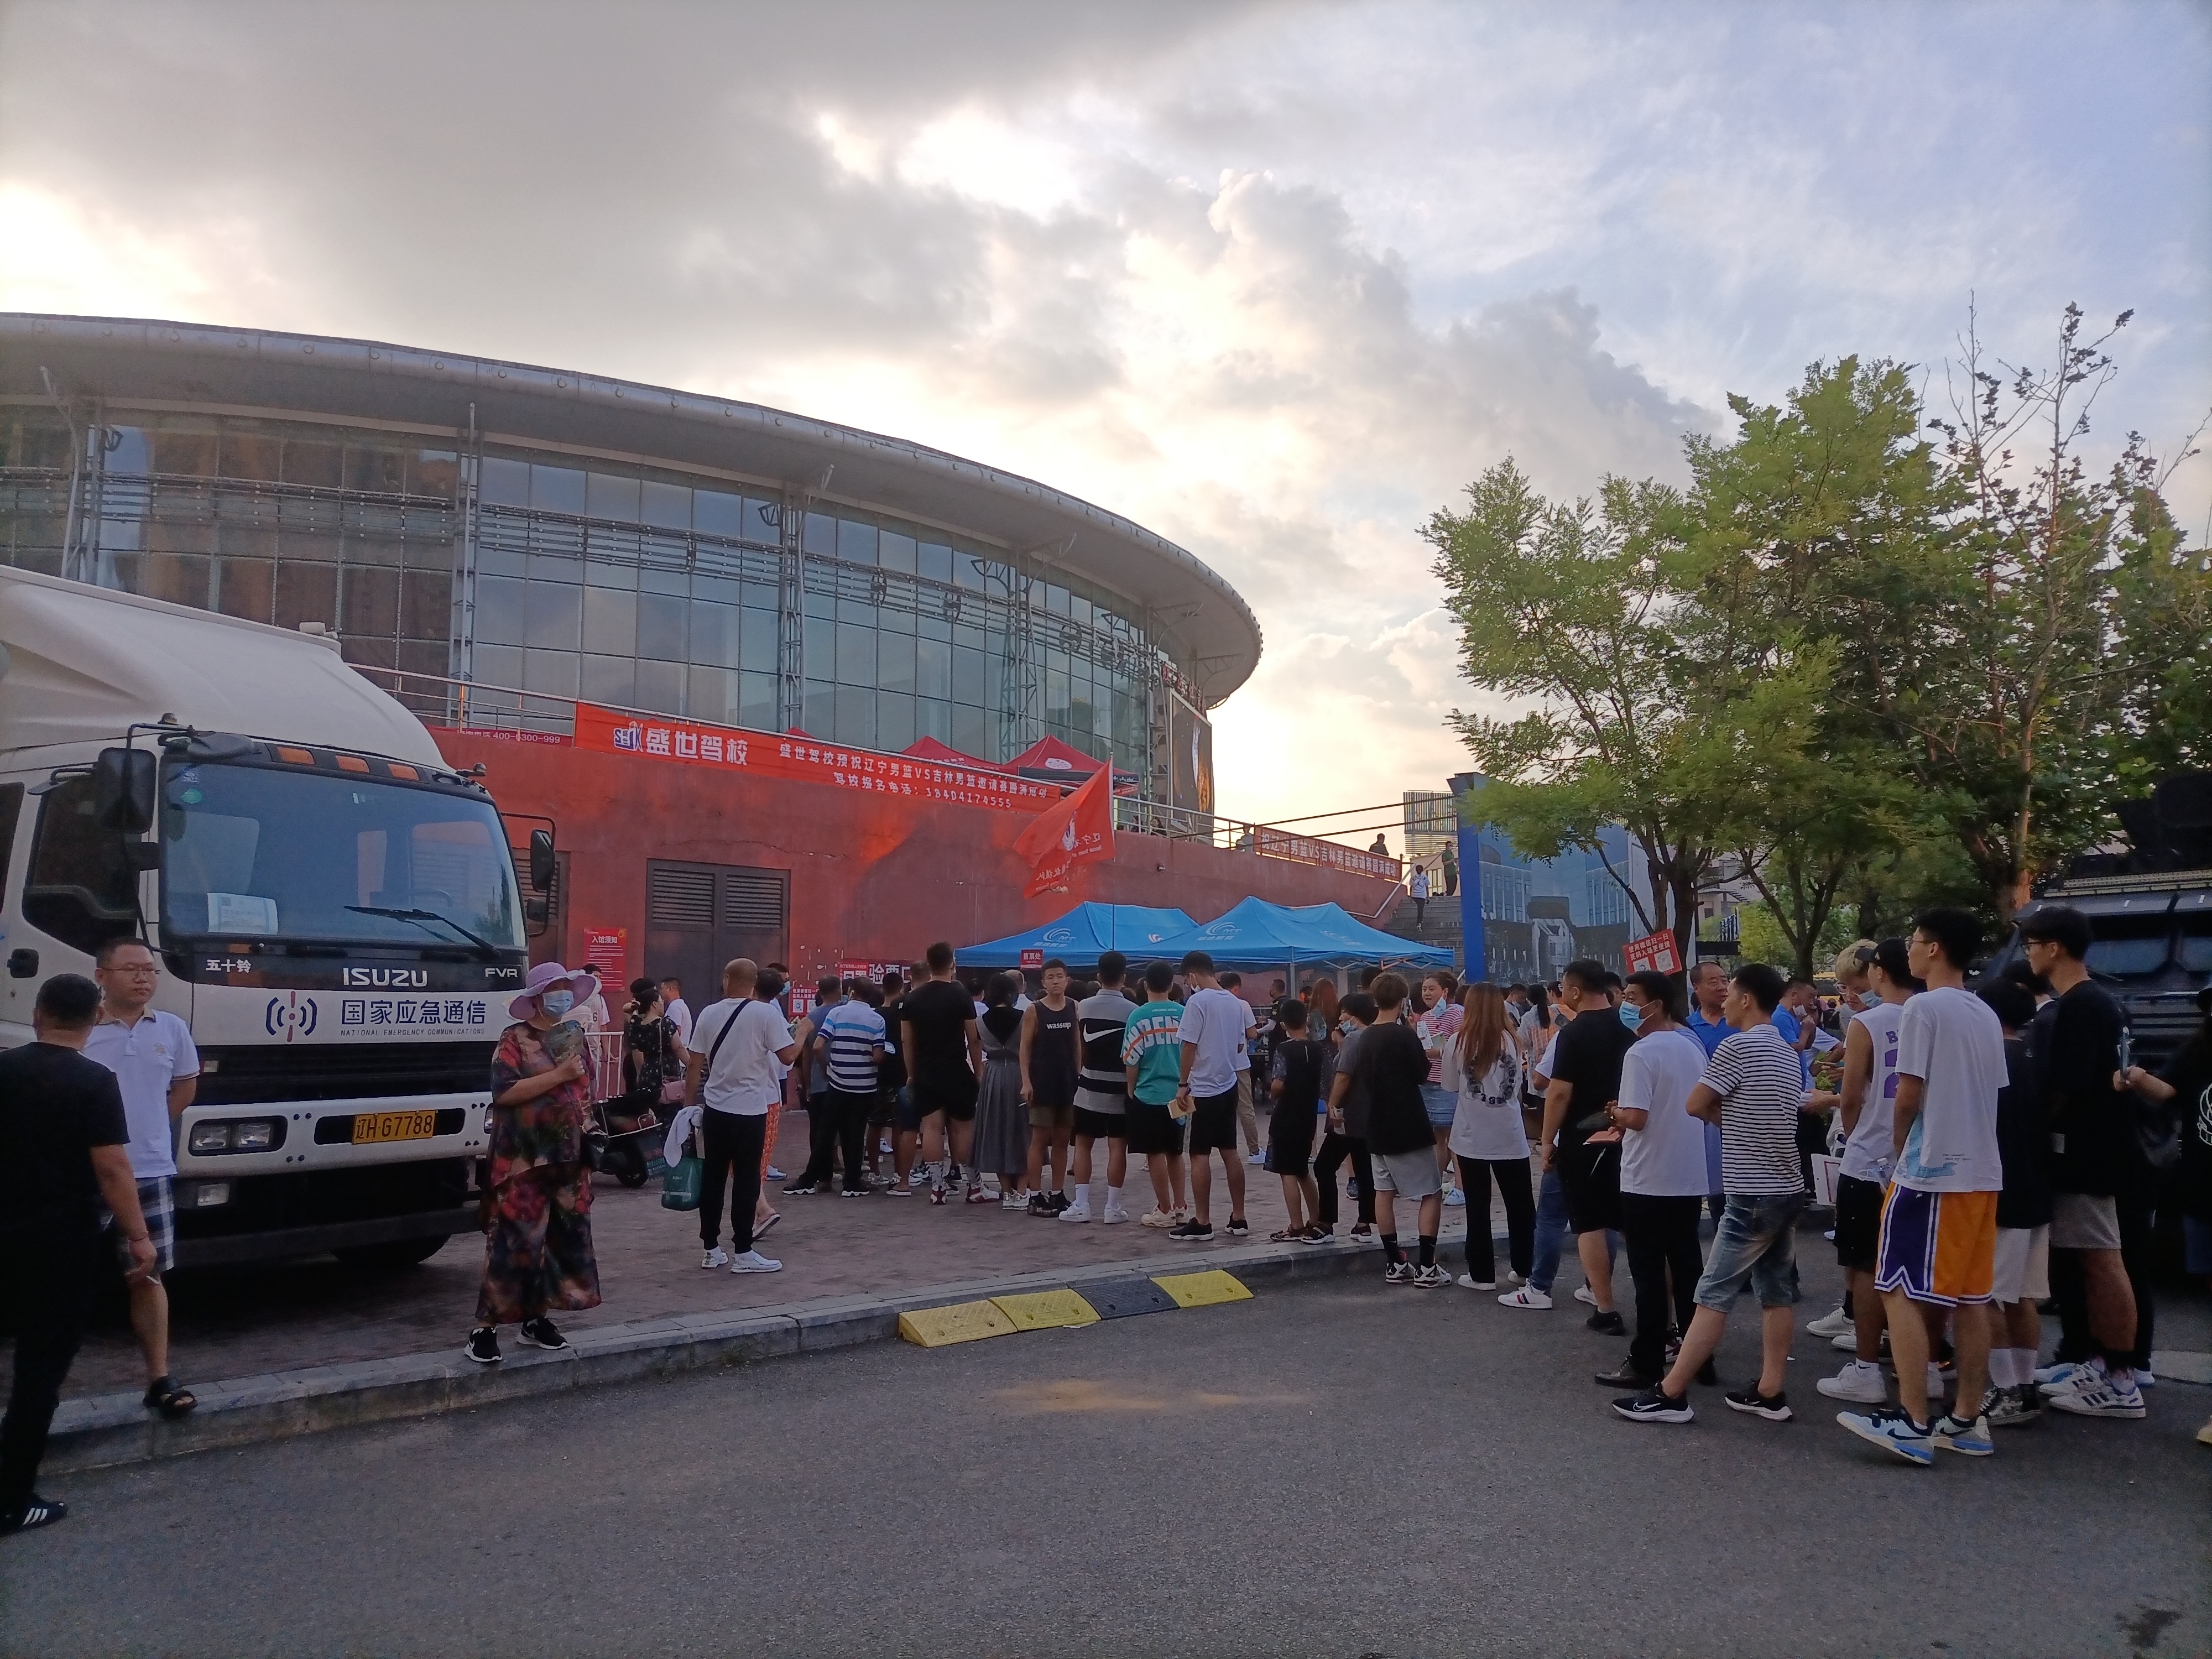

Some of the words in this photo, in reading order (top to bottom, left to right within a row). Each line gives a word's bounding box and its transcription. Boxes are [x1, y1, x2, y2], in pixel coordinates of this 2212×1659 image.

[646, 727, 748, 766] 盛世驾校
[206, 959, 252, 973] 五十铃
[343, 967, 427, 987] ISUZU
[484, 968, 518, 978] FVR
[341, 1000, 486, 1025] 国家应急通信
[355, 1114, 433, 1140] 辽H·G7788
